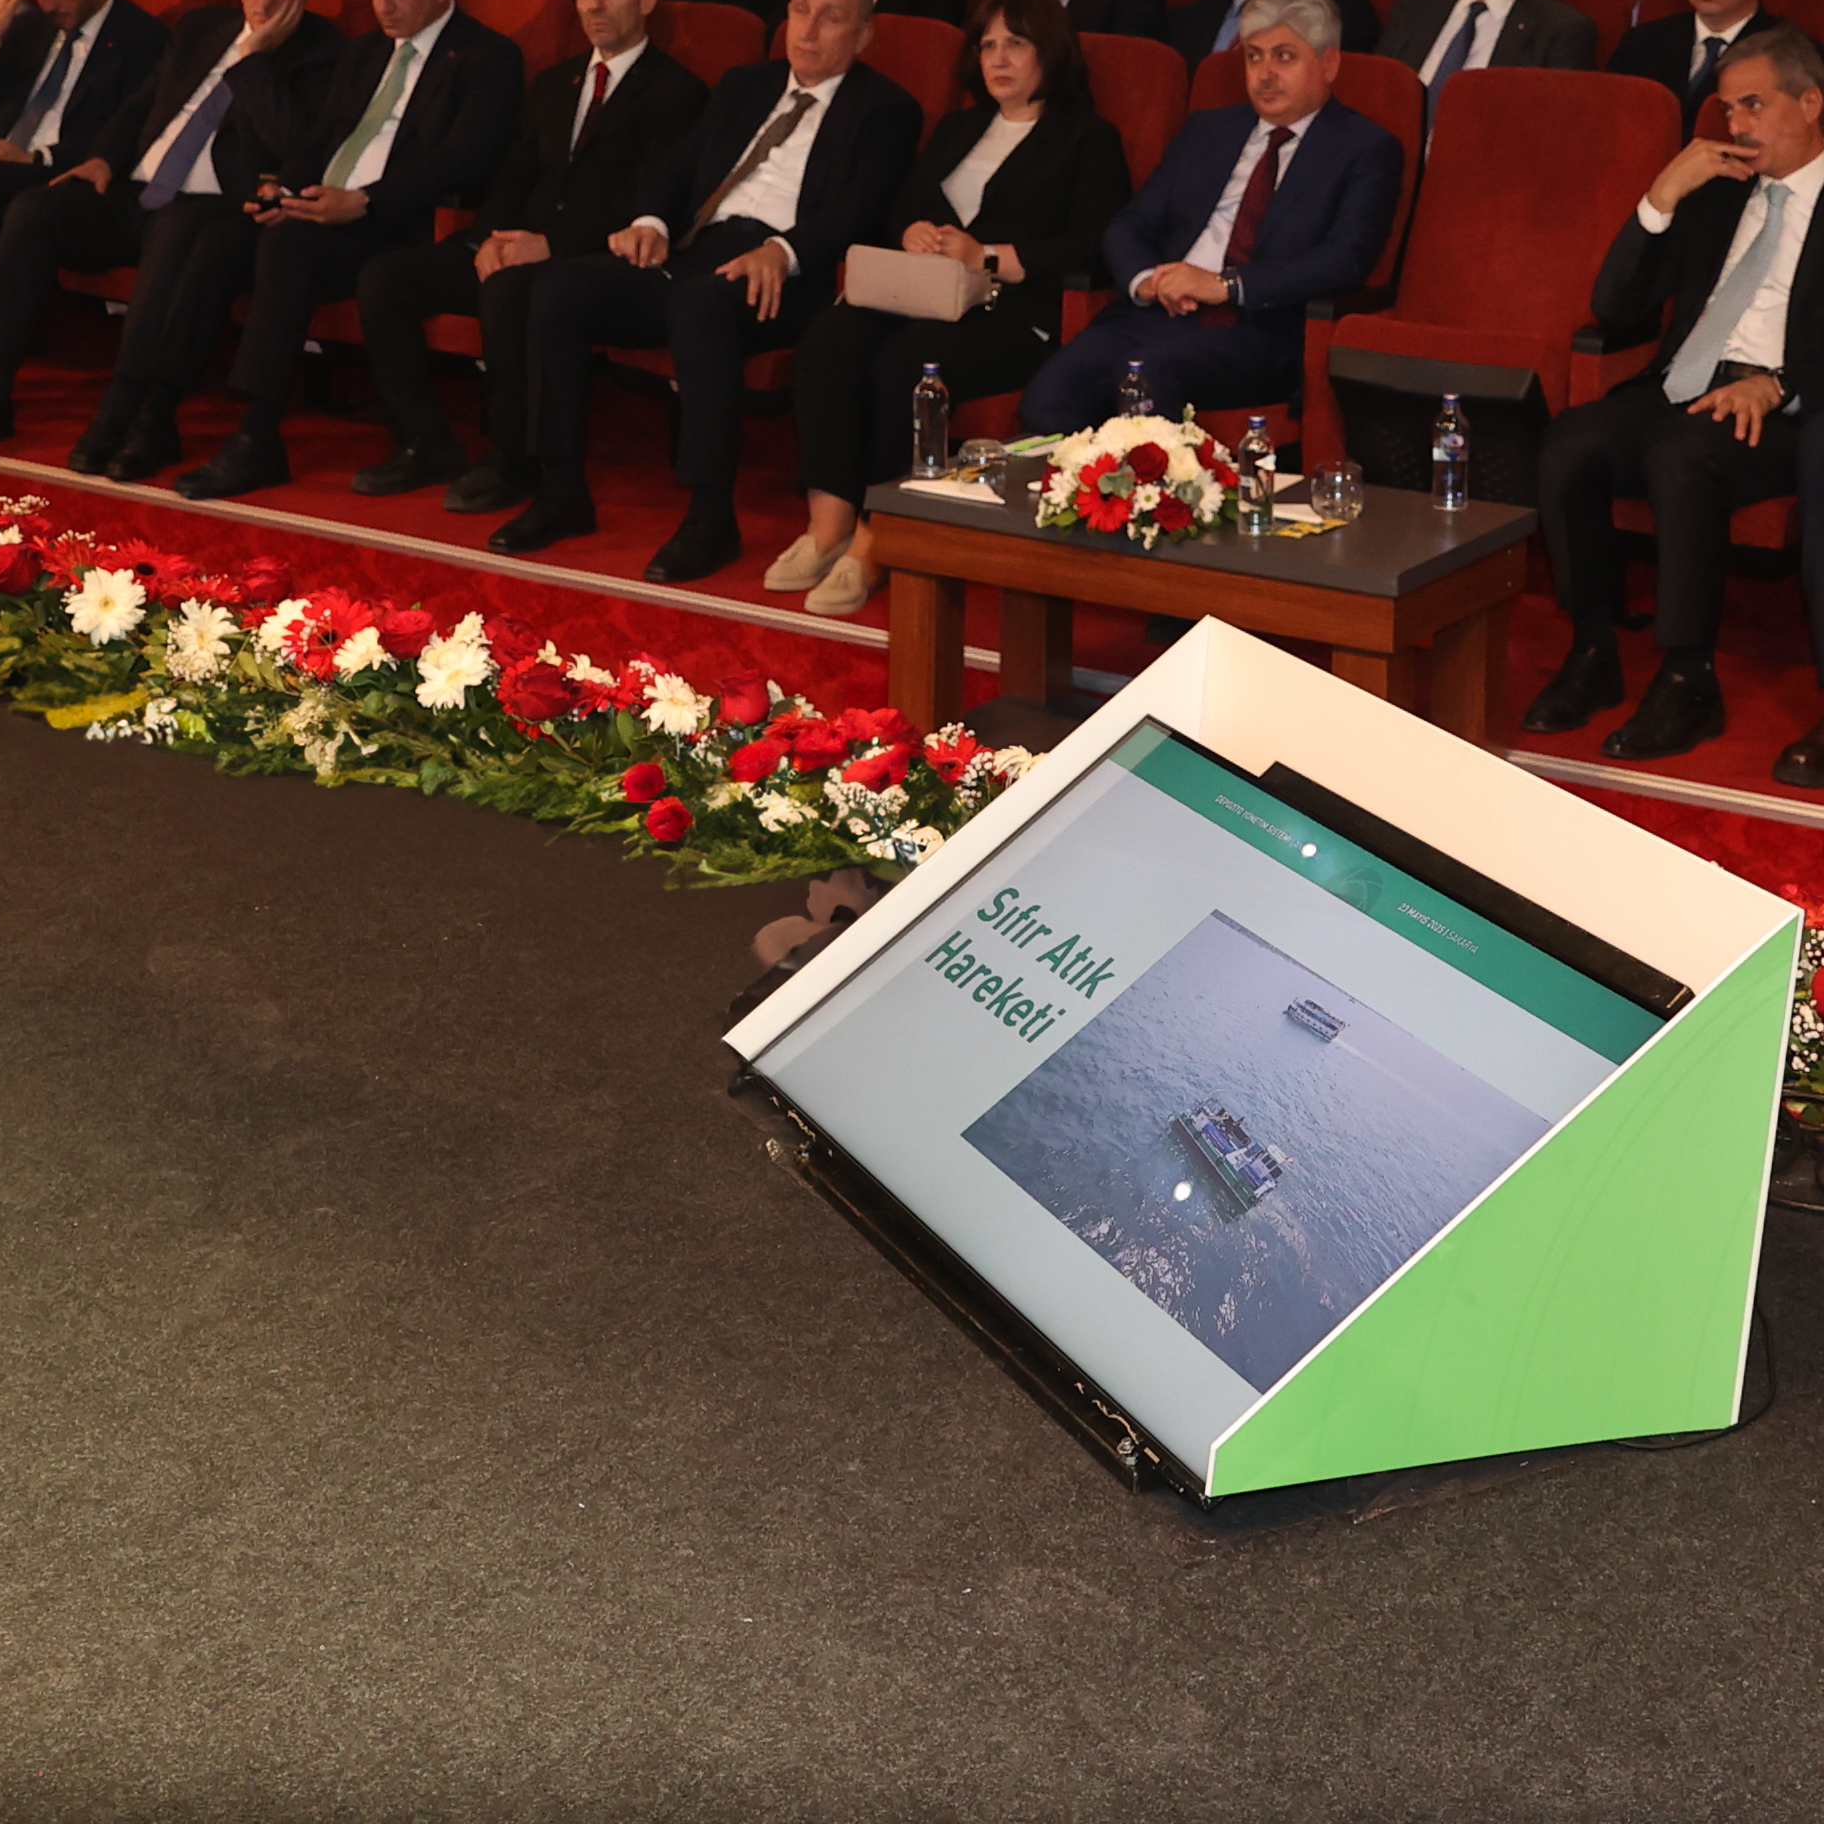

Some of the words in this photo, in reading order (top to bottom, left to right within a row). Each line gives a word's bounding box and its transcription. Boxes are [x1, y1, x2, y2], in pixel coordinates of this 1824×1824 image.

[977, 887, 1053, 949] Sıfır
[1035, 933, 1116, 1000] Atık
[1397, 902, 1410, 913] 23
[1406, 907, 1430, 925] MAYIS
[1427, 919, 1446, 934] 2025
[1446, 931, 1479, 954] SAKARYA
[924, 930, 1067, 1044] Hareketi
